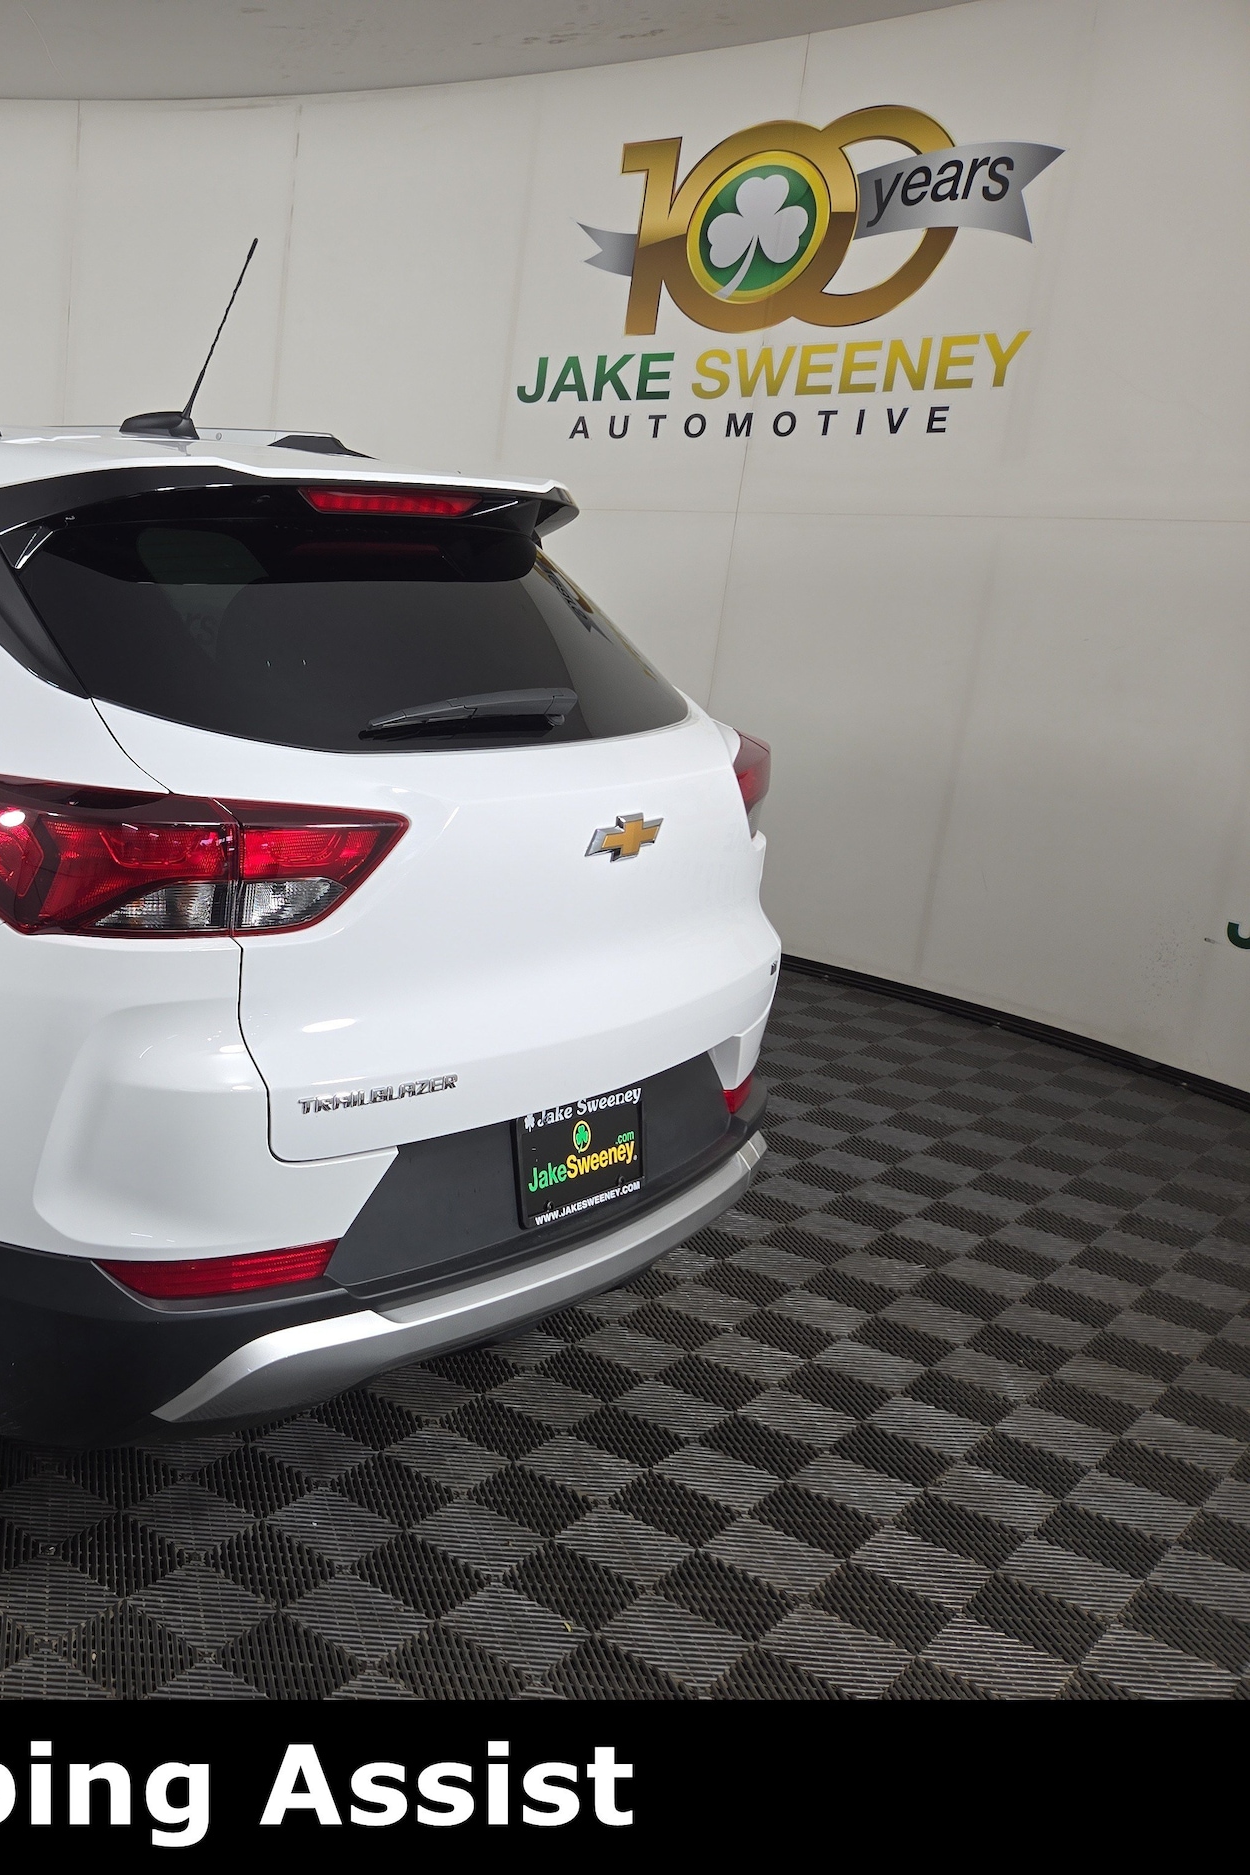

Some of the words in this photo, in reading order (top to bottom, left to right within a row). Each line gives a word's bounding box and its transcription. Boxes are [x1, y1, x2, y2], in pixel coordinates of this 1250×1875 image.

[866, 156, 1015, 228] years
[516, 352, 676, 404] JAKE
[691, 330, 1032, 401] SWEENEY
[569, 405, 951, 441] AUTOMOTIVE
[297, 1073, 459, 1115] TRAILBLAZER
[537, 1106, 573, 1128] Jake
[576, 1087, 642, 1116] Sweeney
[534, 1180, 641, 1226] WWW.JAKESWEENEY.COM
